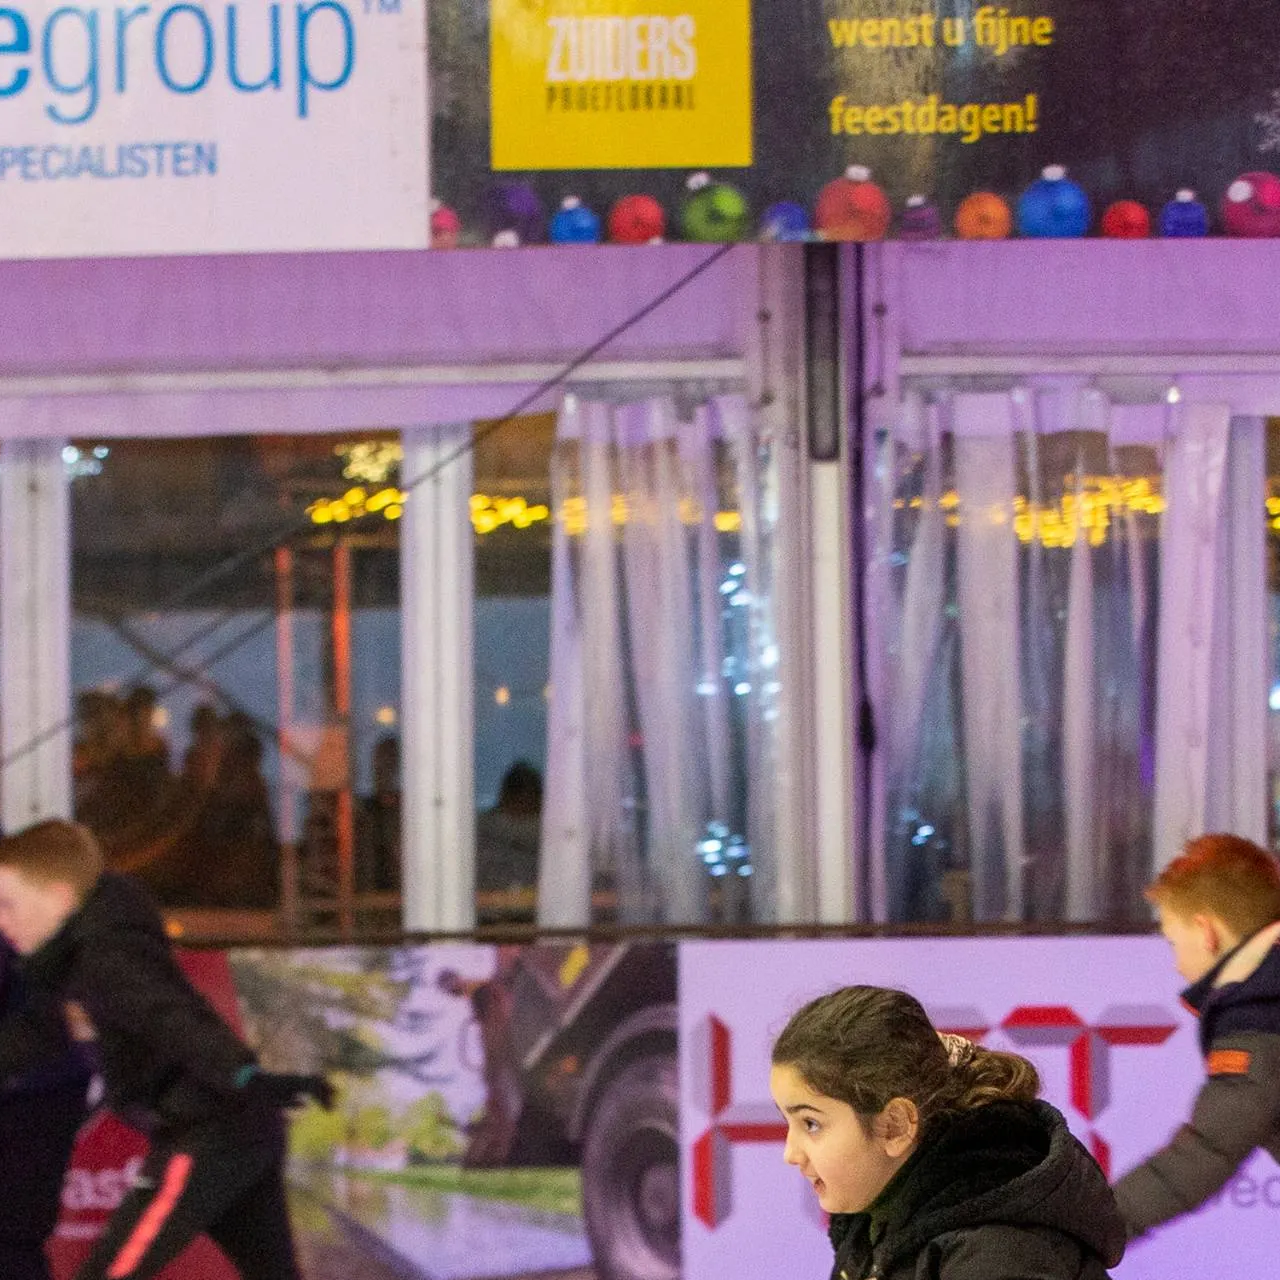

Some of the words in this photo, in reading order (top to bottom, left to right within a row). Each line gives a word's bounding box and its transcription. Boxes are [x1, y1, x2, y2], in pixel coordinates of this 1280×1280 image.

[545, 14, 697, 82] ZUIDERS
[827, 14, 935, 47] wenst
[943, 18, 964, 46] u
[975, 6, 1055, 56] fijne
[829, 93, 1038, 143] feestdagen!
